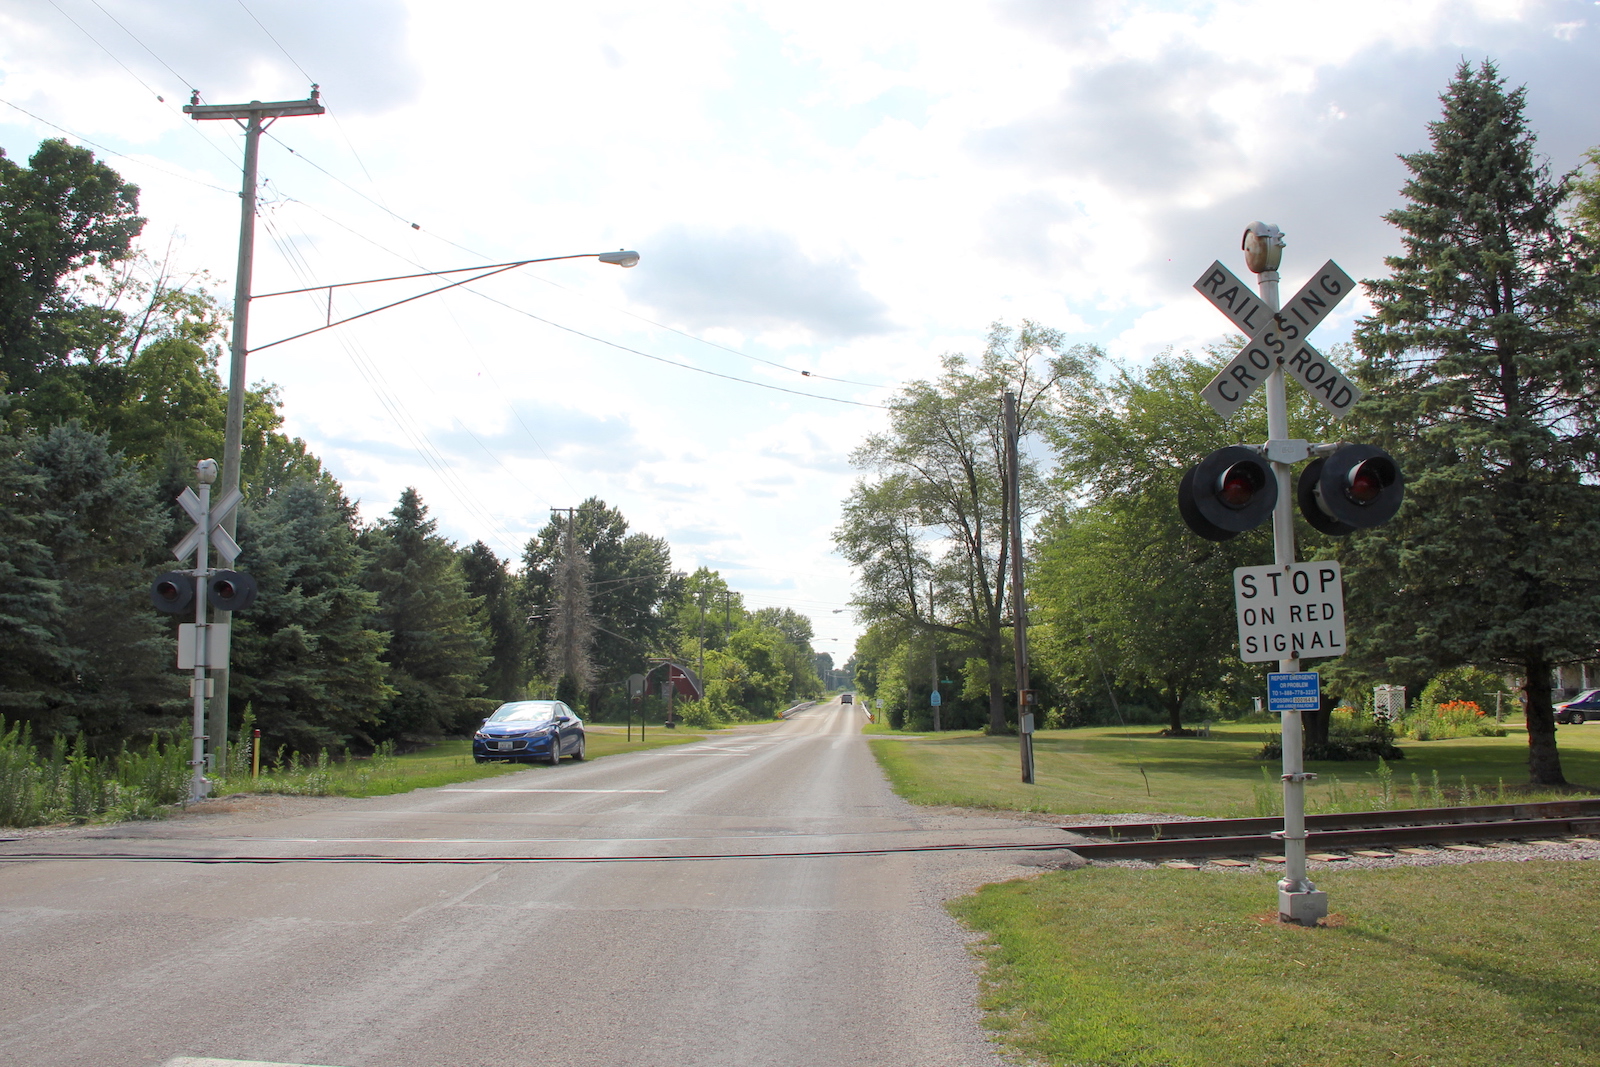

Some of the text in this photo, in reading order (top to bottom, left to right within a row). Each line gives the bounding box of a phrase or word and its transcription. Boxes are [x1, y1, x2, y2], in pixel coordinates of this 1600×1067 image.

[1202, 268, 1353, 409] RAIL ROAD
[1217, 274, 1341, 402] CROSSING
[1241, 569, 1335, 599] STOP
[1243, 602, 1334, 626] ON RED
[1246, 630, 1341, 654] SIGNAL
